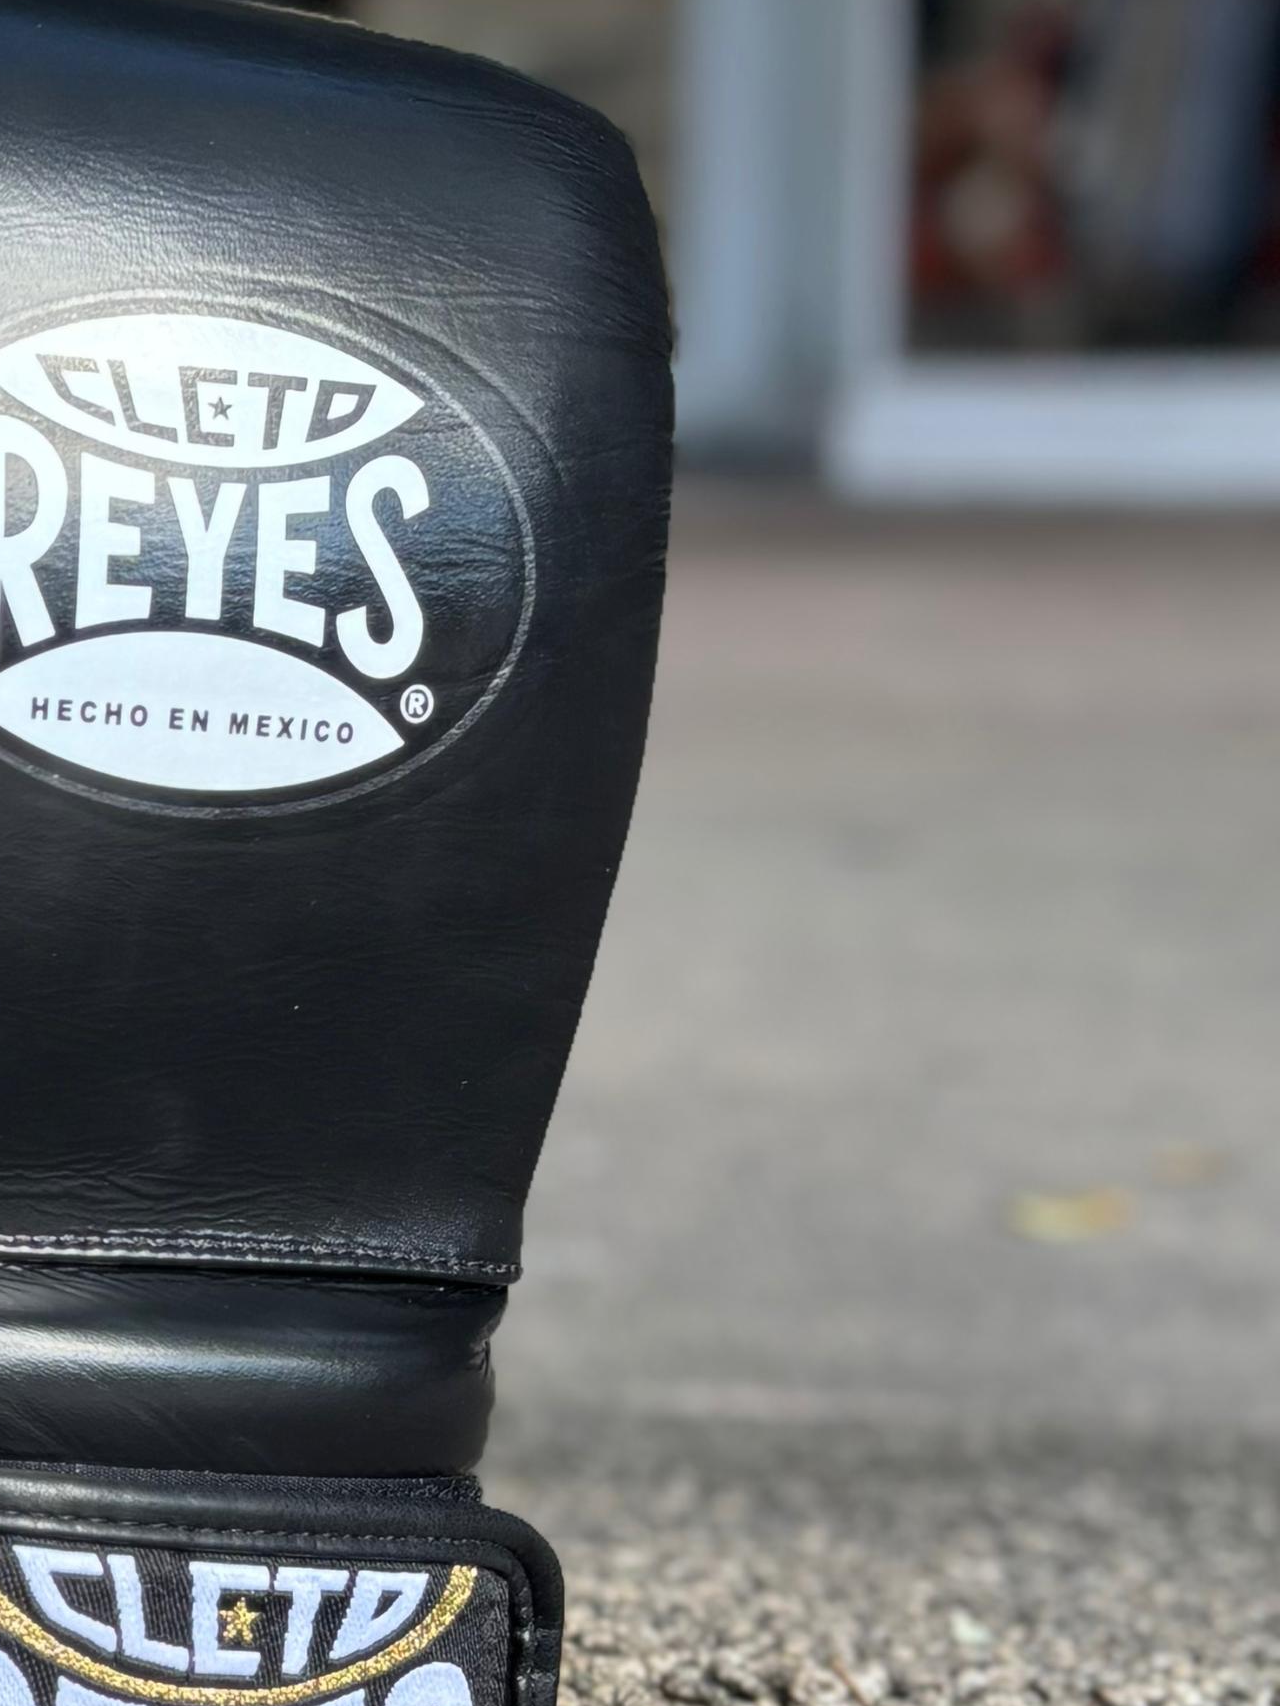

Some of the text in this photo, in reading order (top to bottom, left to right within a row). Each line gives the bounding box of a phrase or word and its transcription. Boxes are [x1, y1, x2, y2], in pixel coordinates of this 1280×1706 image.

[35, 353, 378, 450] CLETO
[30, 697, 355, 744] HECHO EN MEXICO
[13, 1544, 429, 1677] CLETO
